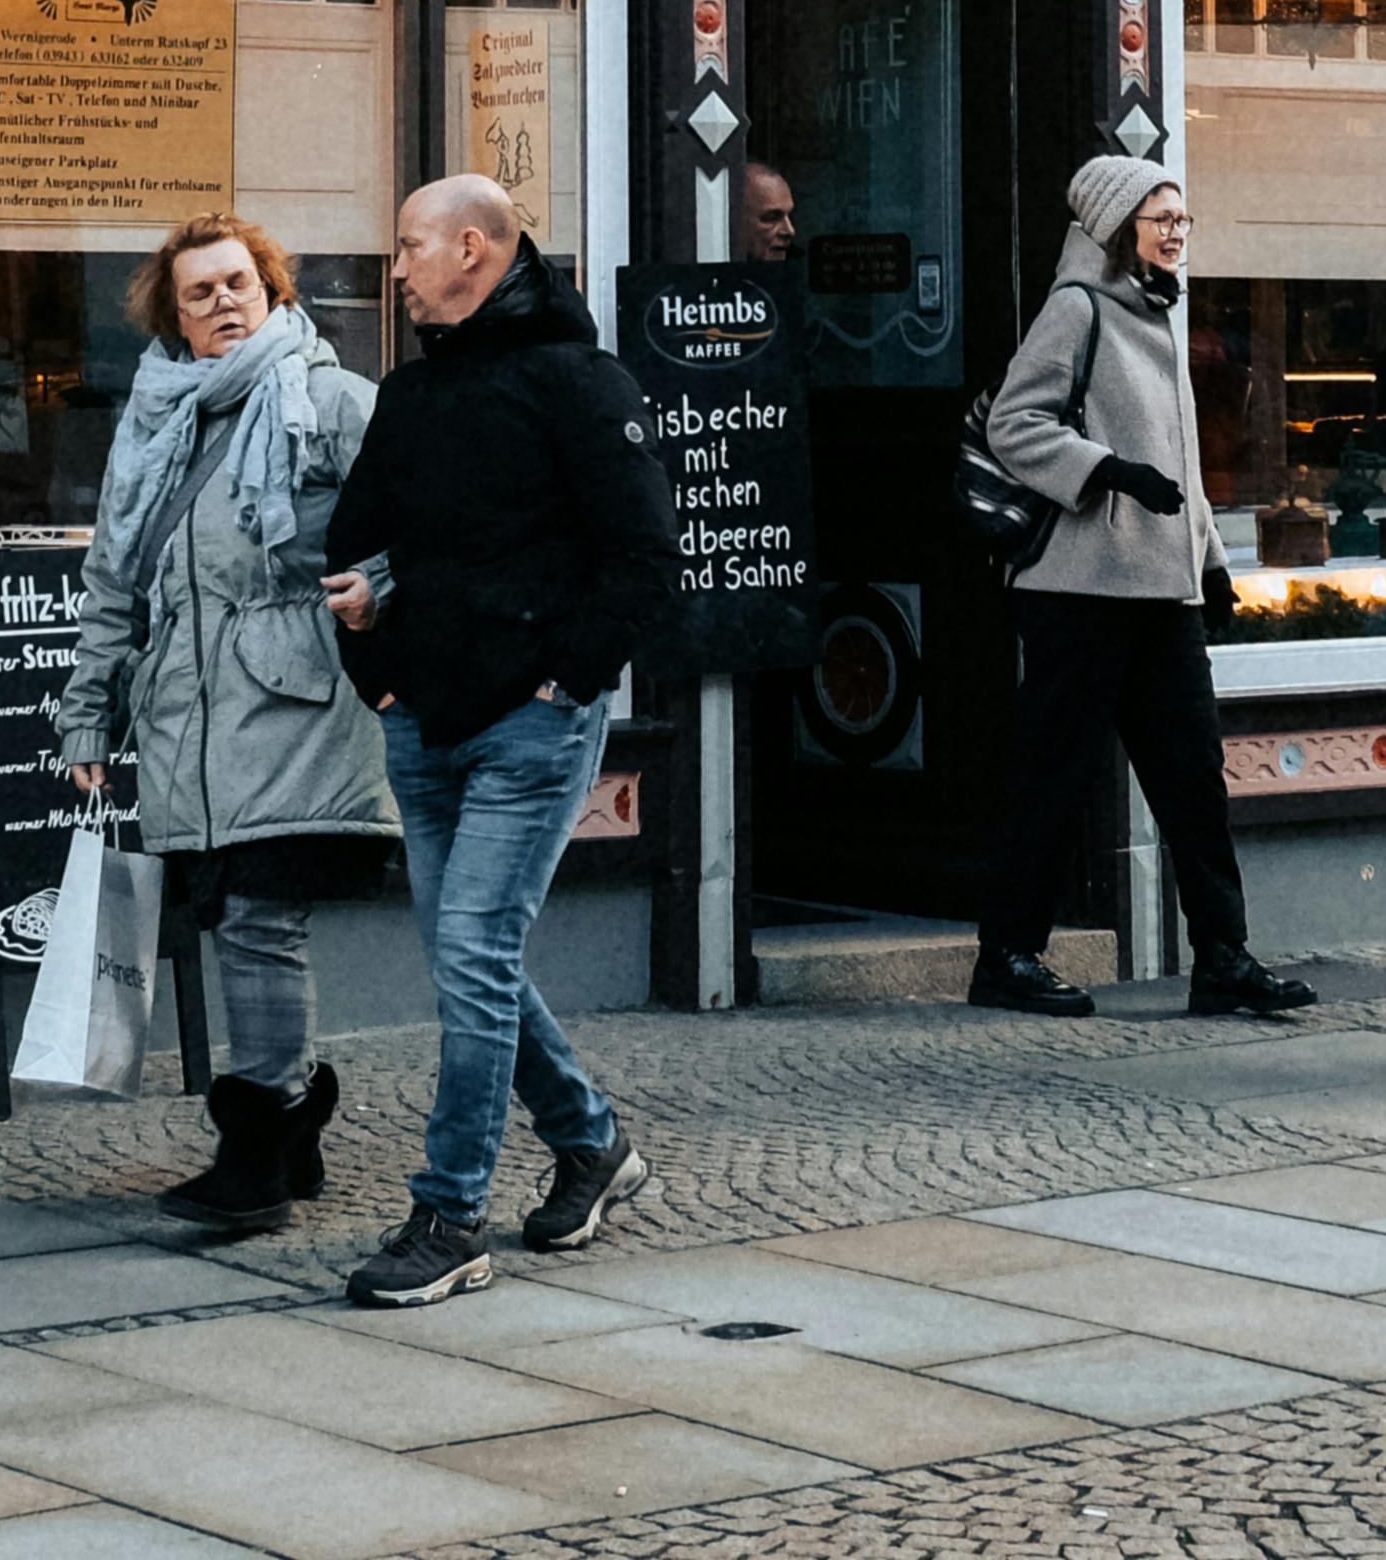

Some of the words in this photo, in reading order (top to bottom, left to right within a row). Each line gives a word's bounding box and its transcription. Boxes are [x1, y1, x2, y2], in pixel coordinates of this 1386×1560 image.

[1, 30, 77, 45] Wernigerode
[482, 30, 533, 54] Original
[133, 54, 159, 66] oder
[59, 75, 147, 91] Doppelzimmer
[77, 94, 120, 107] Telefon
[124, 96, 146, 107] und
[150, 96, 199, 109] Minibar
[135, 117, 158, 129] und
[59, 155, 118, 171] Parkplatz
[43, 177, 136, 193] Ausgangspunkt
[139, 178, 159, 190] für
[162, 179, 222, 192] erholsame
[72, 195, 84, 207] in
[87, 196, 109, 207] den
[113, 196, 143, 209] Harz
[660, 291, 767, 327] Heimbs
[685, 342, 742, 359] KAFFEE
[655, 390, 788, 439] isbecher
[685, 437, 731, 474] mit
[675, 476, 760, 510] ischen
[679, 520, 791, 557] dbeeren
[680, 560, 714, 592] nd
[724, 556, 807, 591] Sahne
[4, 818, 46, 832] warmer
